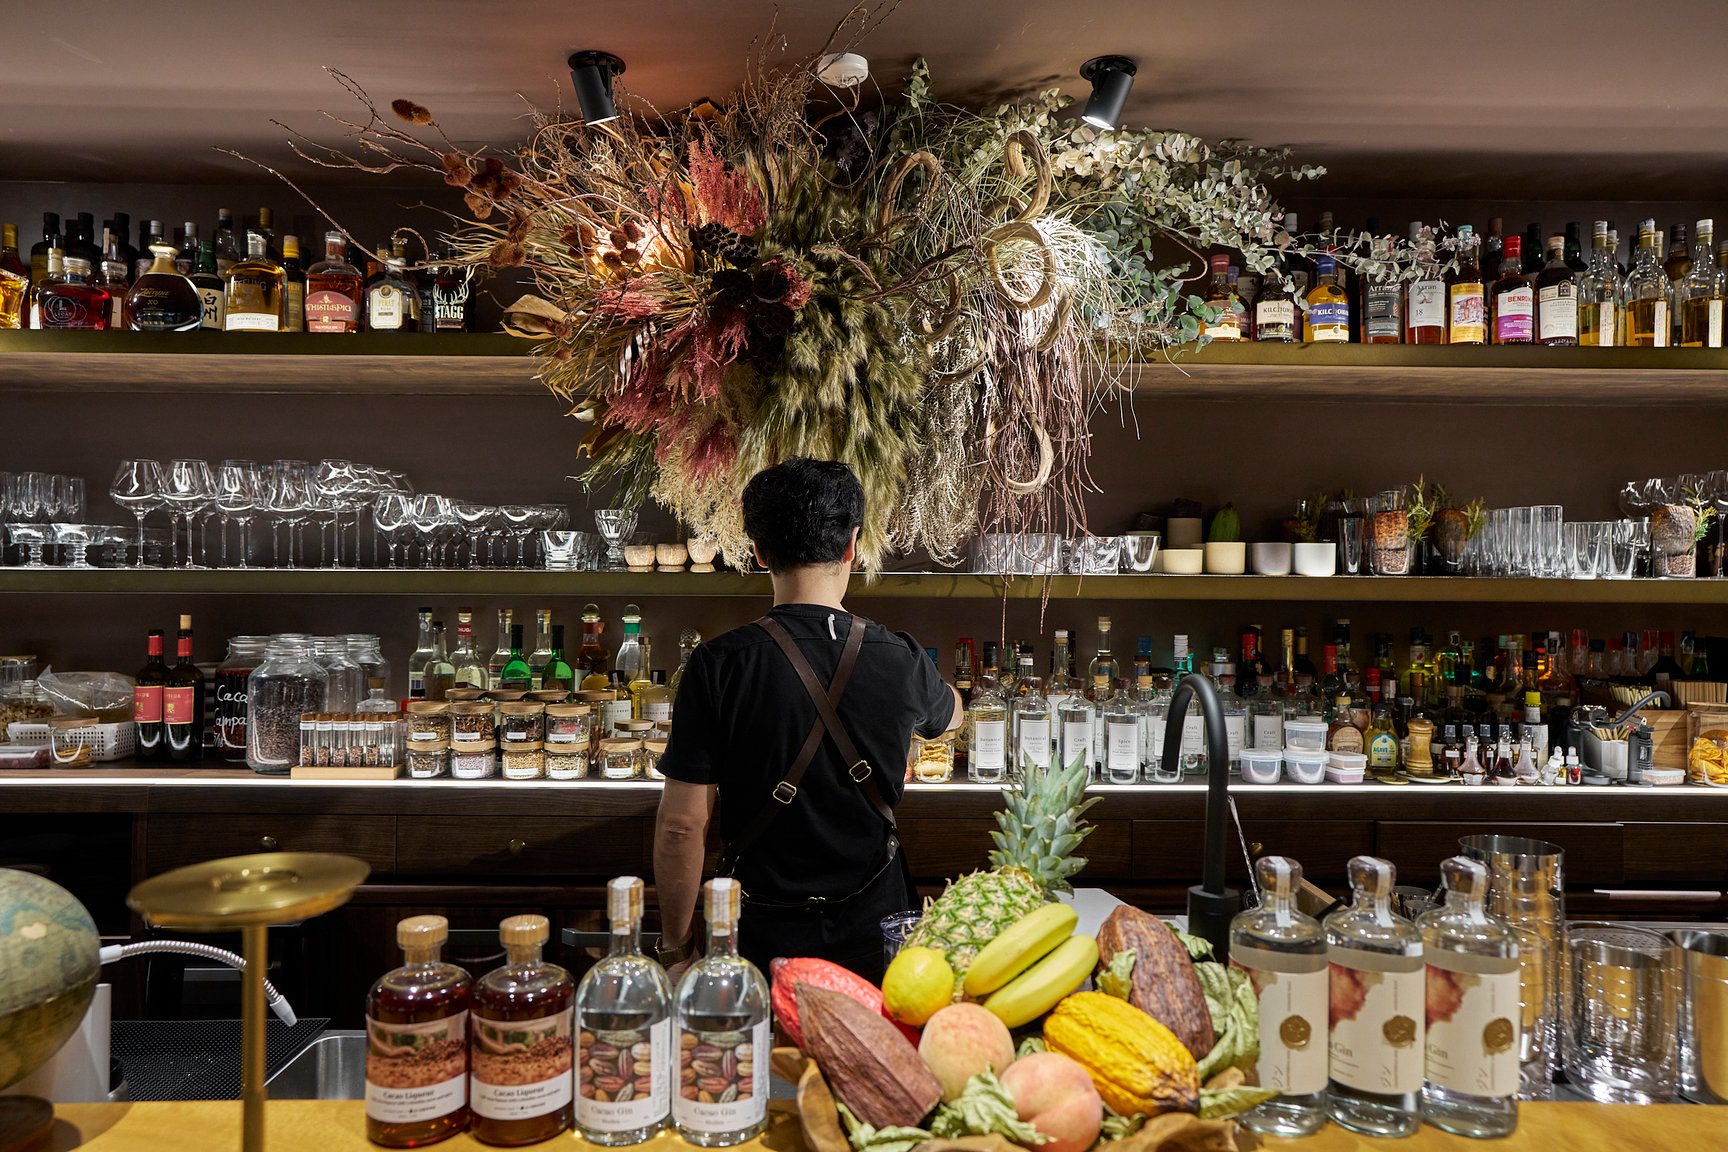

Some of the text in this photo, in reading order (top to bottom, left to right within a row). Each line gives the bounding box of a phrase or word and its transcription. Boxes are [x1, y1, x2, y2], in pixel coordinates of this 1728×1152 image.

[203, 292, 218, 322] 白州
[435, 305, 464, 319] STAGG
[1335, 1042, 1353, 1058] Gin
[383, 1091, 404, 1100] Cacao
[405, 1089, 435, 1101] Liqueur
[494, 1088, 515, 1097] Cacao
[516, 1086, 545, 1098] Liqueur
[591, 1105, 634, 1116] Cacao Gin
[693, 1107, 737, 1118] Cacao Gin
